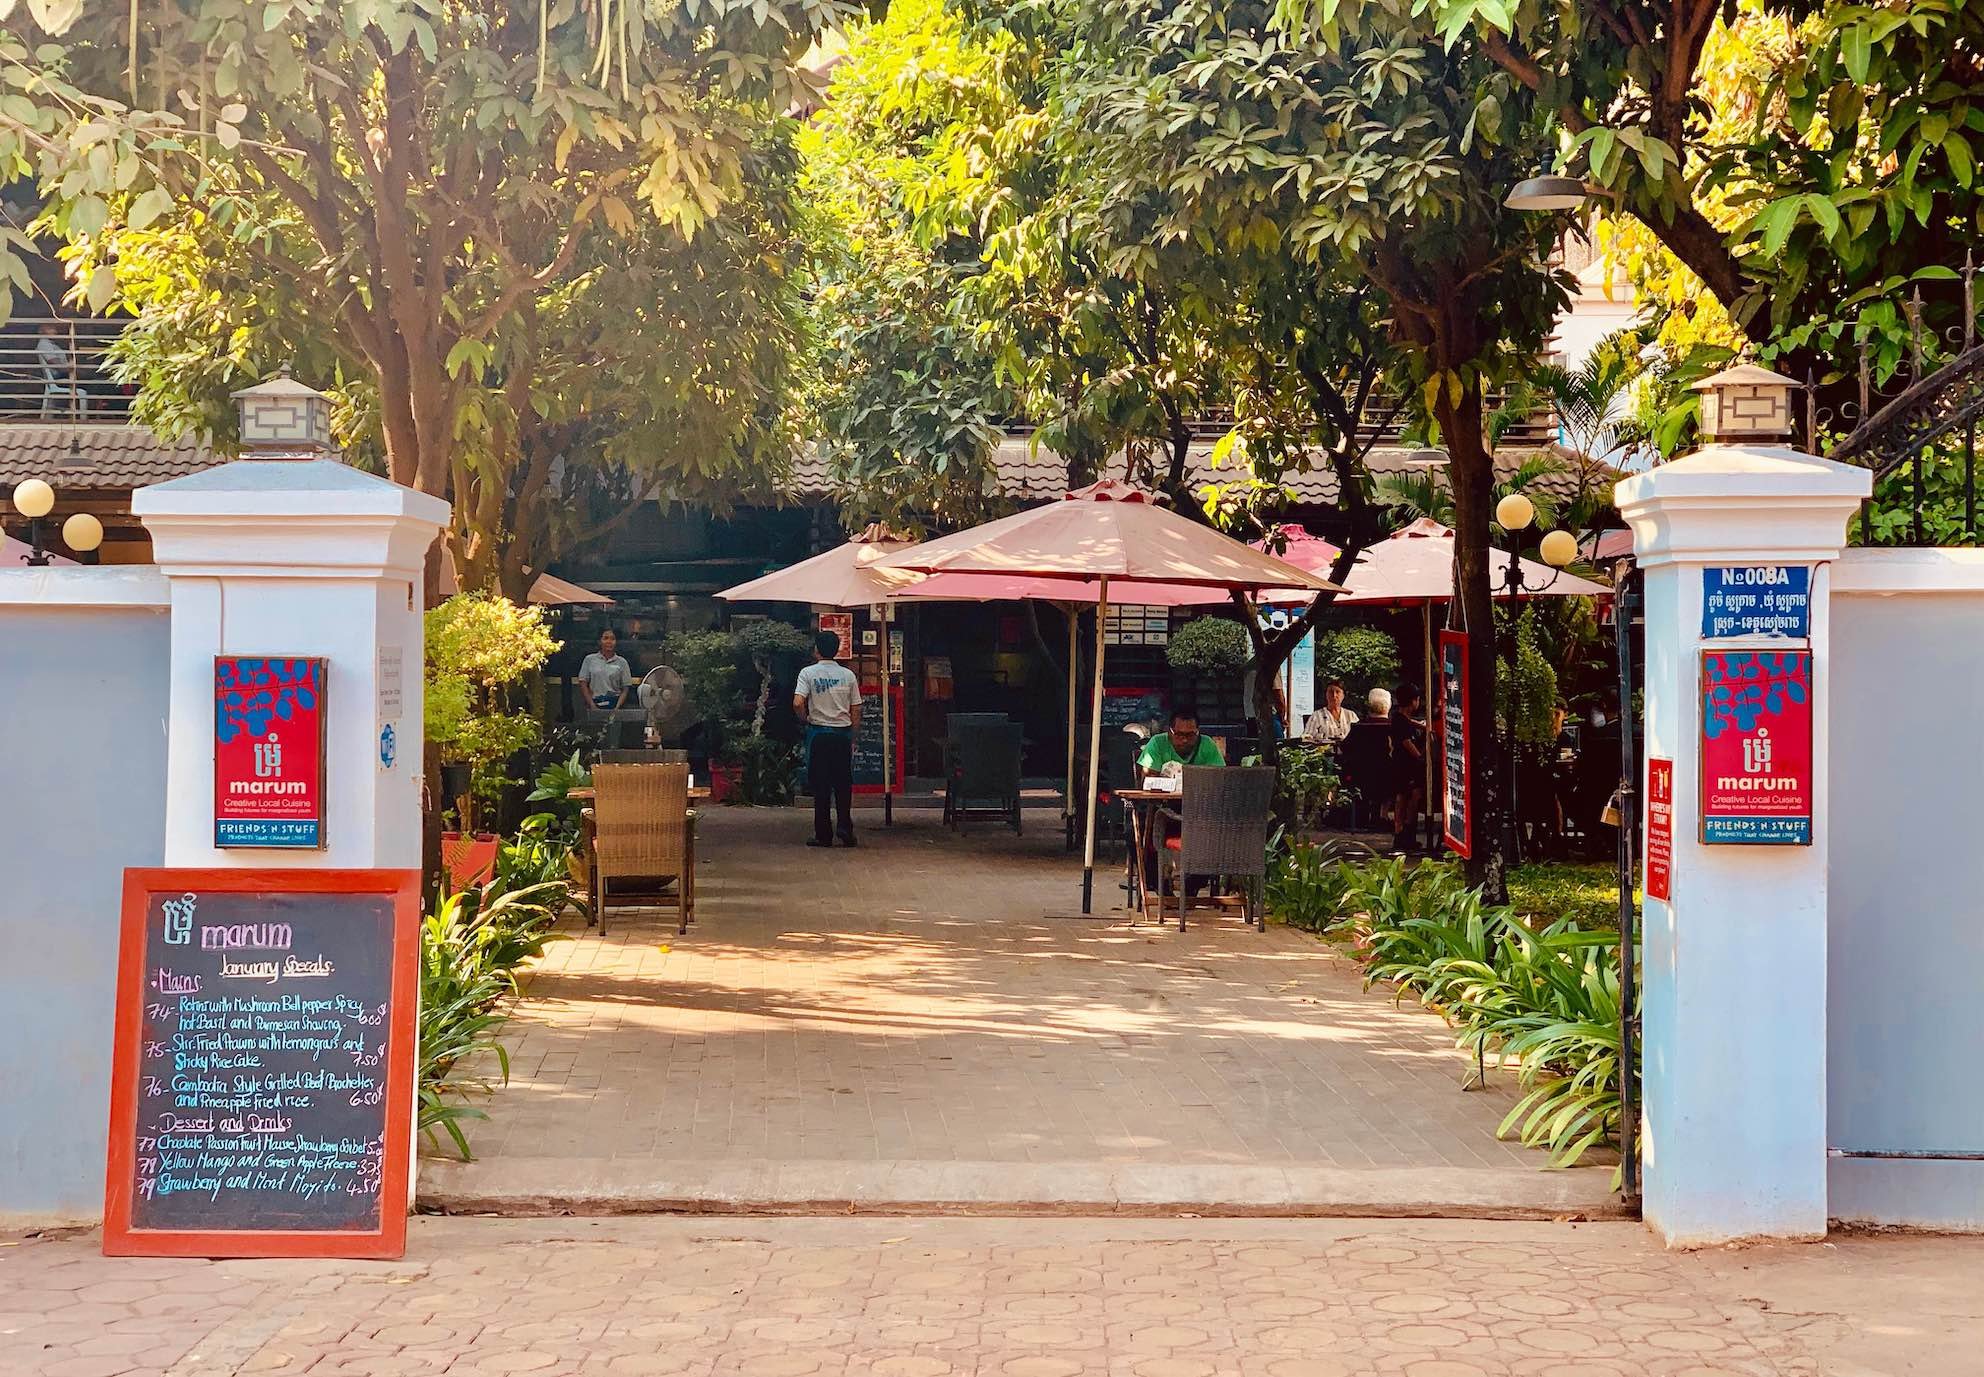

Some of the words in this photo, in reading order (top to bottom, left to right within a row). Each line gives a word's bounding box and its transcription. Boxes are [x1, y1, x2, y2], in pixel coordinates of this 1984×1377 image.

[229, 780, 307, 795] marum
[1717, 776, 1798, 791] marum
[224, 798, 257, 808] Creative
[258, 798, 281, 808] Local
[281, 798, 312, 808] Cuisine
[1711, 795, 1746, 804] Creative
[1747, 795, 1771, 804] Local
[1771, 795, 1803, 804] Cuisine
[220, 824, 267, 834] FRIENDS
[281, 824, 315, 834] STUFF
[1707, 821, 1756, 831] FRIENDS
[1772, 821, 1807, 831] STUFF
[201, 922, 293, 949] marum
[219, 953, 279, 985] January
[208, 996, 233, 1013] with
[234, 994, 281, 1013] Mushroom
[302, 999, 334, 1015] pepper
[179, 1014, 196, 1031] hot
[196, 1013, 227, 1030] Basil
[230, 1013, 252, 1030] and
[255, 1015, 300, 1031] Parmesan
[222, 1032, 257, 1051] Prawns
[258, 1032, 281, 1050] with
[342, 1031, 365, 1052] and
[175, 1052, 208, 1073] Sticky
[210, 1052, 234, 1069] Rice
[171, 1073, 228, 1093] Cambodia
[233, 1073, 263, 1097] Style
[264, 1071, 302, 1091] Grilled
[301, 1069, 324, 1091] Beef
[174, 1093, 198, 1107] and
[199, 1093, 252, 1114] Pineapple
[158, 1110, 216, 1134] Dessert
[219, 1111, 244, 1133] and
[247, 1109, 293, 1133] Drinks
[204, 1134, 239, 1151] Passion
[236, 1132, 261, 1152] Fruit
[159, 1151, 195, 1173] Yellow
[196, 1151, 235, 1176] Mango
[236, 1151, 264, 1169] and
[263, 1153, 295, 1169] Green
[297, 1153, 323, 1174] Apple
[225, 1171, 252, 1189] and
